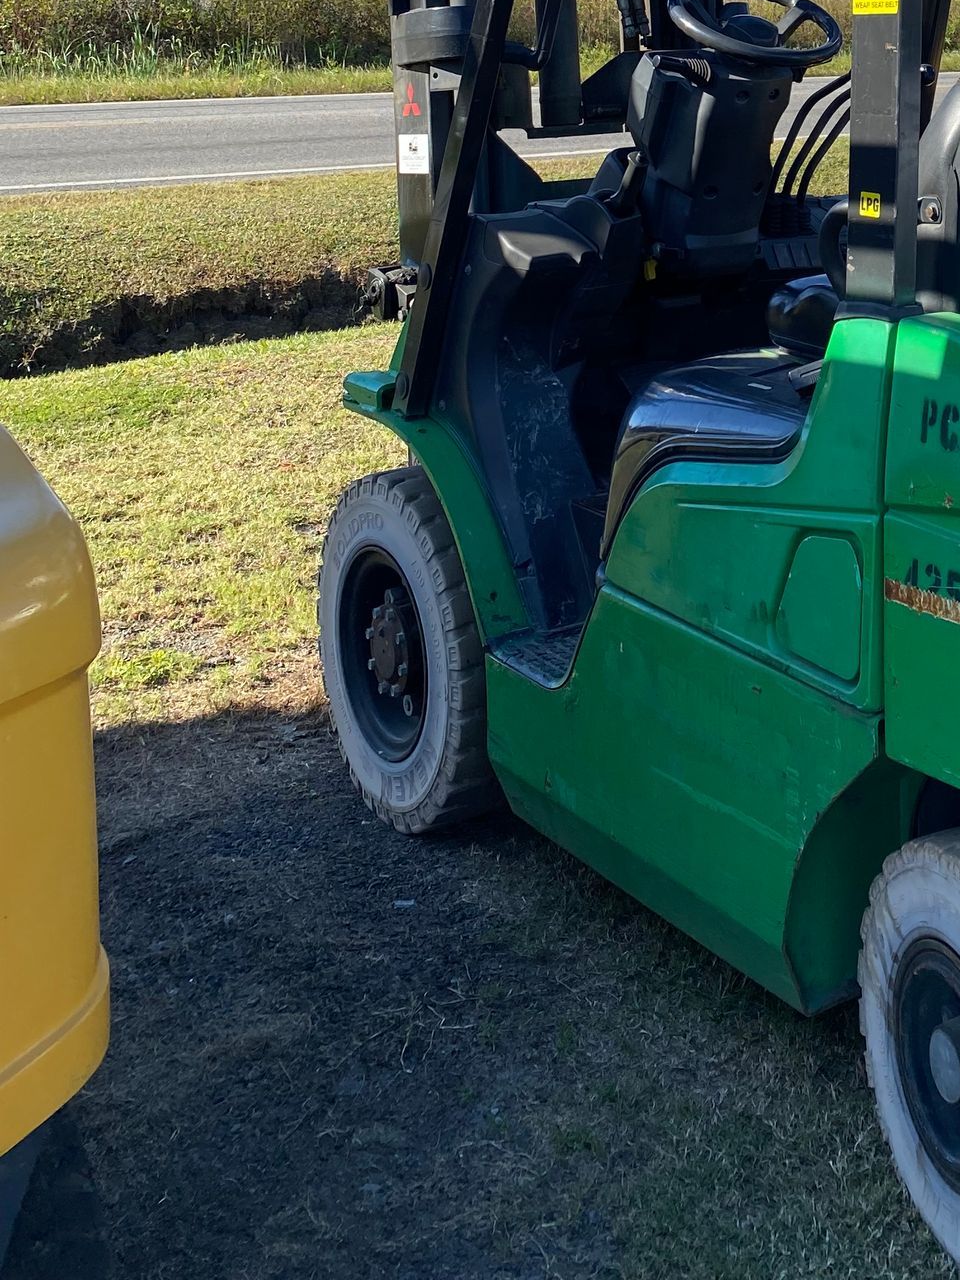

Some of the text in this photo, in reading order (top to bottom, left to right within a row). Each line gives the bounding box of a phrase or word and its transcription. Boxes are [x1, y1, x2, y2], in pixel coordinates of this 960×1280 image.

[856, 1, 871, 9] WEAR
[886, 0, 899, 8] BELT
[861, 196, 880, 212] LPG
